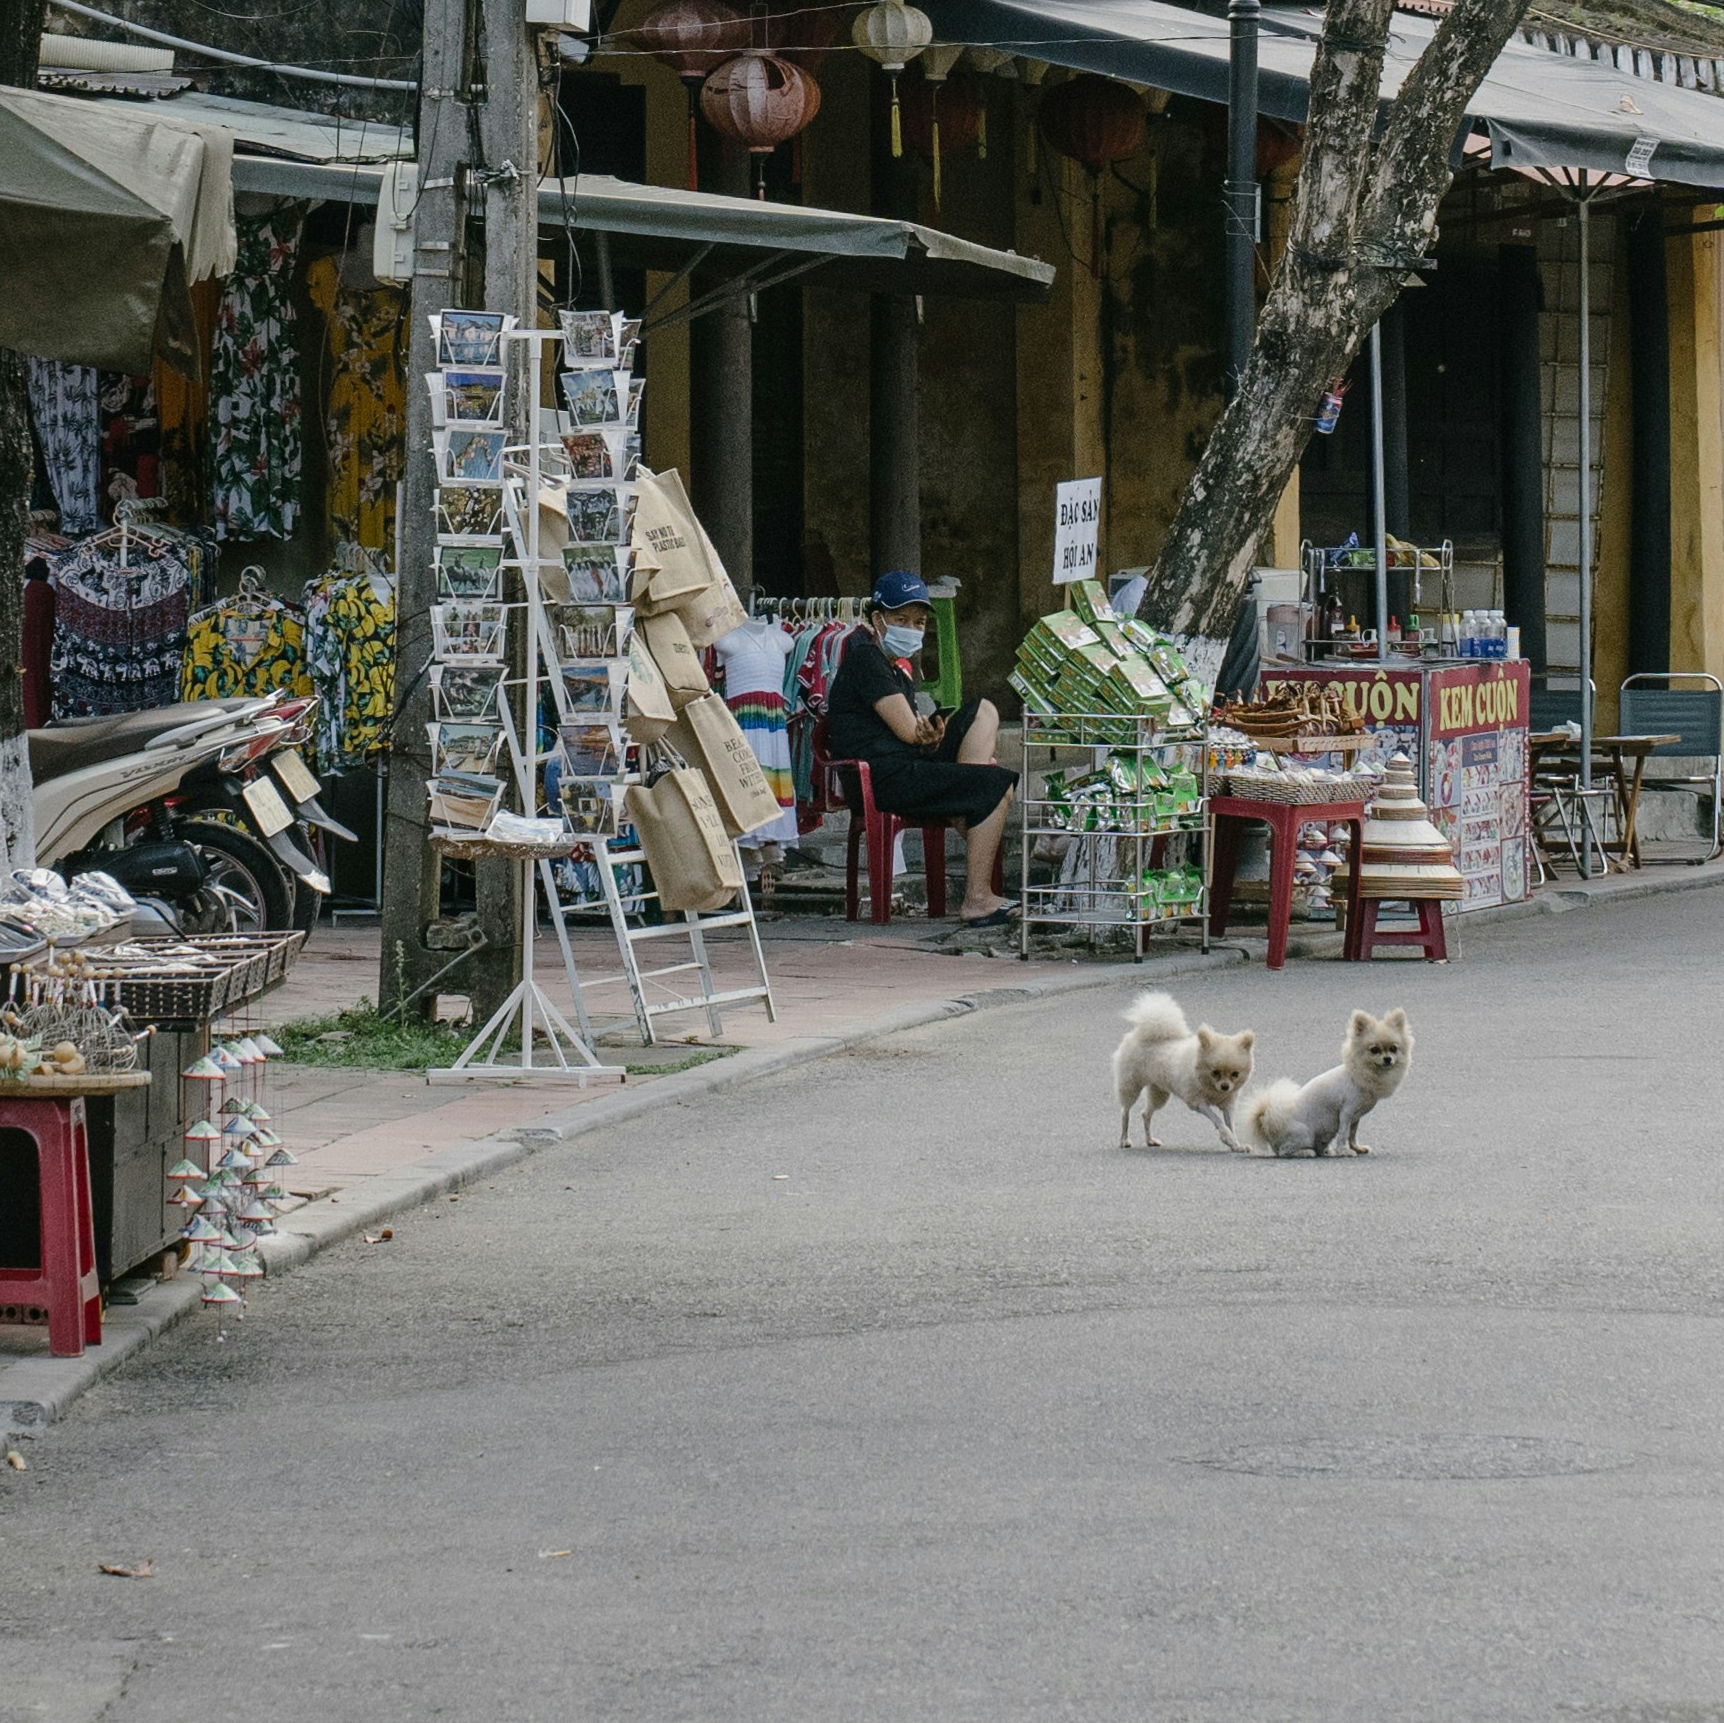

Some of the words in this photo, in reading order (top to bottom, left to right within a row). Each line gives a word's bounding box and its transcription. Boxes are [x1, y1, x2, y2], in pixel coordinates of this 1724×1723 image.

[1079, 543, 1095, 567] AN
[1440, 684, 1474, 731] KEM
[1475, 667, 1519, 732] CUỘN
